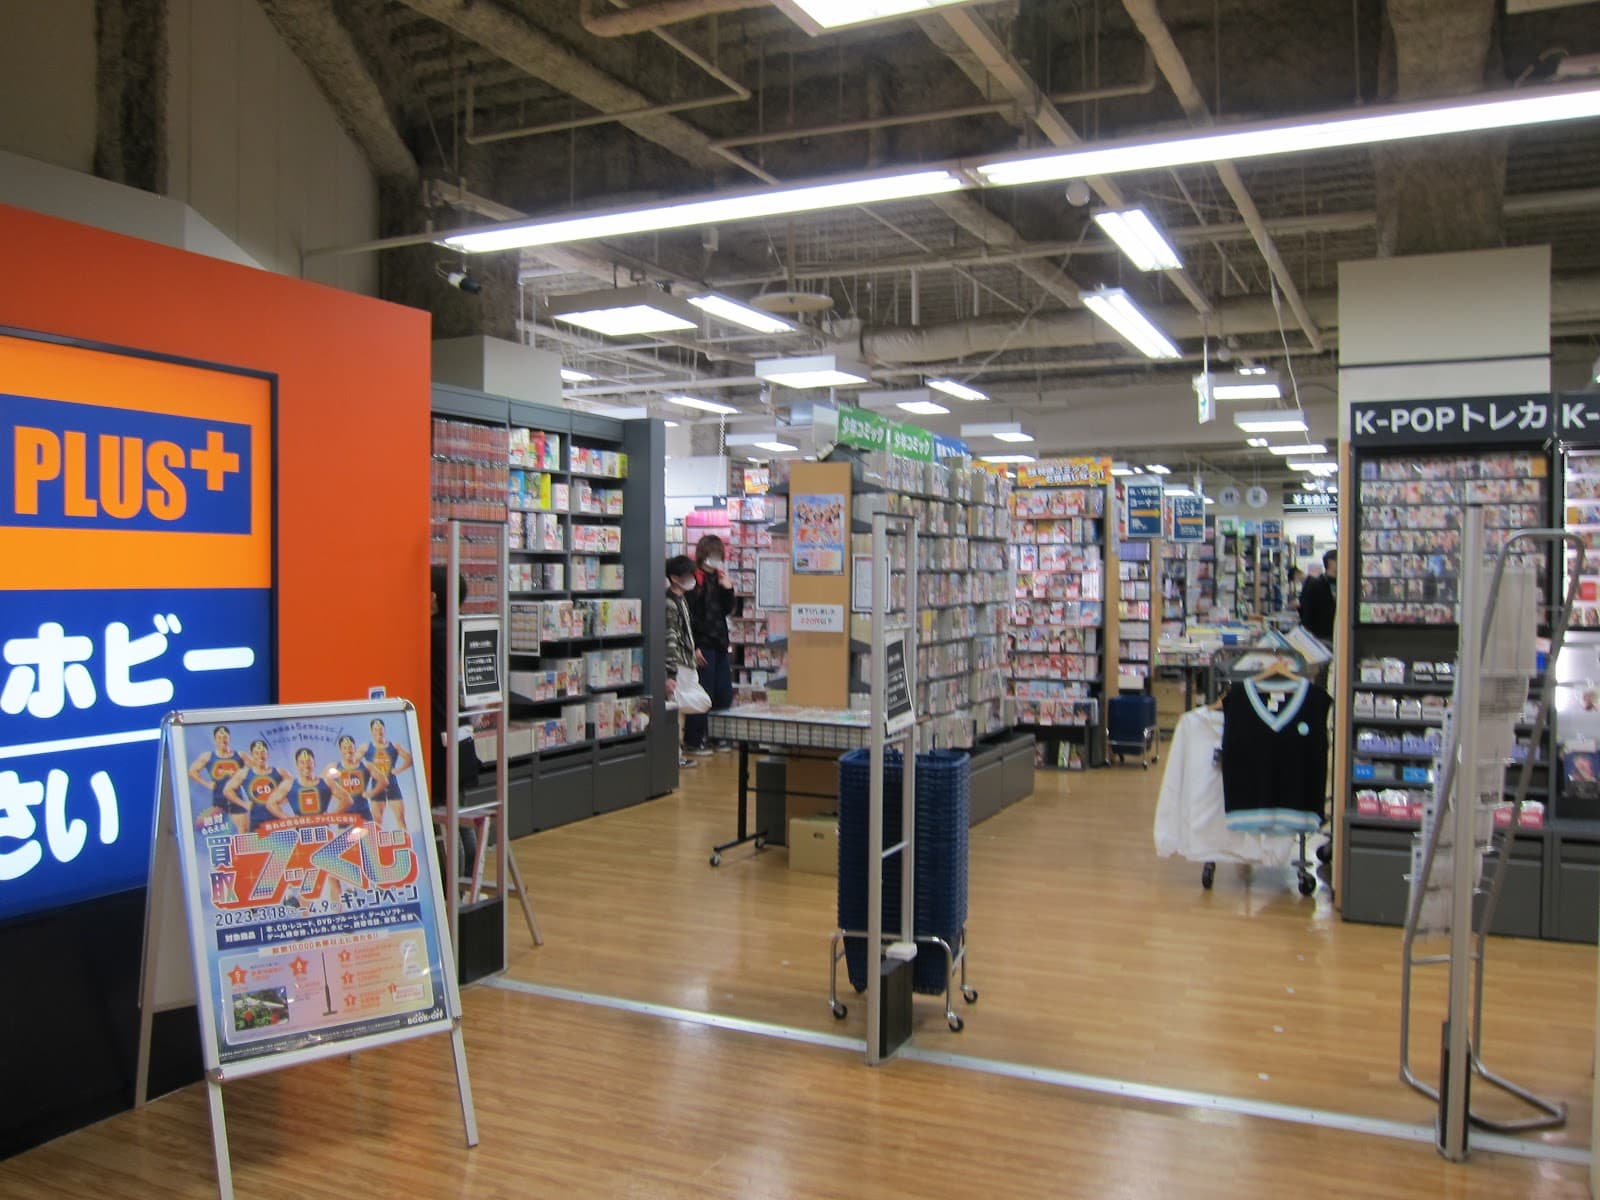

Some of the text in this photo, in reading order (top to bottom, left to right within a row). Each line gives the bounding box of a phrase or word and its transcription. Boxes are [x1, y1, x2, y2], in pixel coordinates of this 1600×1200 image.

[1355, 400, 1548, 434] K-POPトレカ
[2, 613, 255, 719] ホビー
